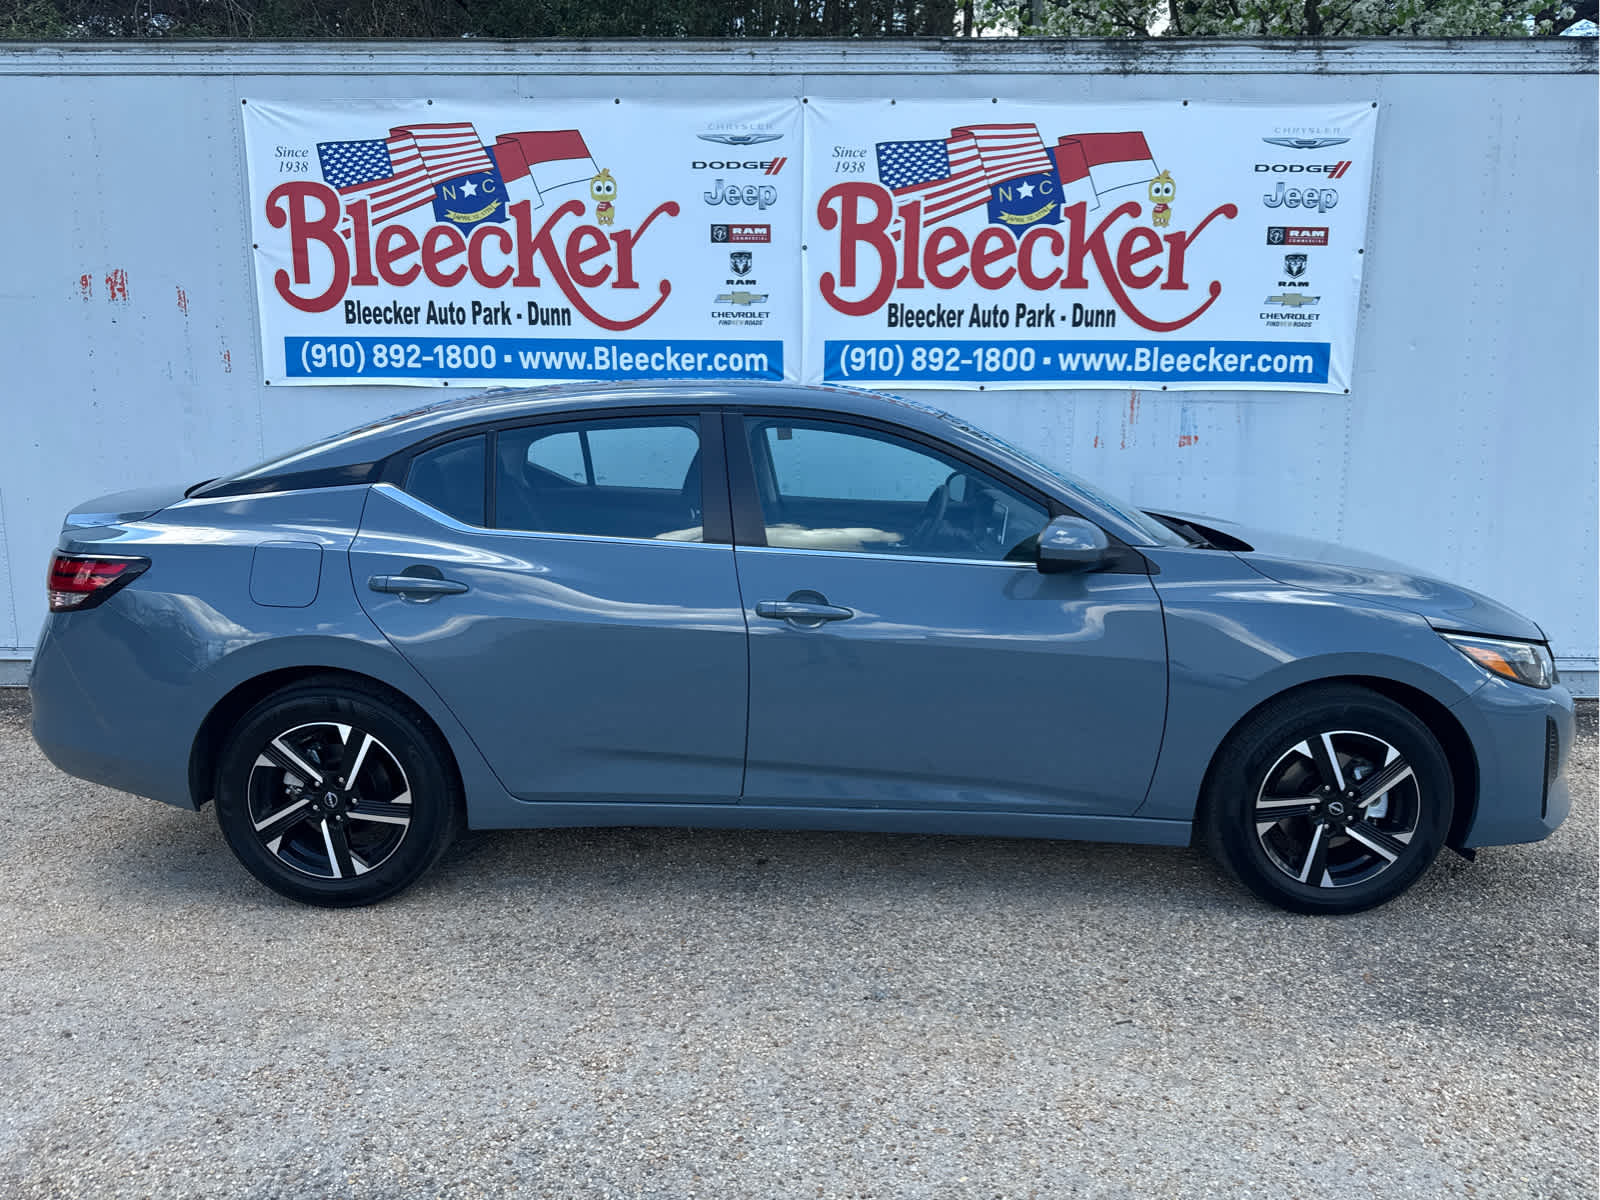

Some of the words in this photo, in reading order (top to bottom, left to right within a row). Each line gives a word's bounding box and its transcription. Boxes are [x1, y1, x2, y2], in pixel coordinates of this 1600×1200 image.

[1274, 127, 1342, 135] CHRYSLER
[275, 145, 309, 158] Since
[832, 146, 867, 159] Since
[279, 161, 309, 172] 1938
[692, 161, 773, 169] DODGE
[833, 162, 865, 173] 1938
[1254, 164, 1337, 172] DODGE
[442, 185, 456, 200] N
[482, 179, 496, 193] C
[704, 179, 778, 210] Jeep
[999, 186, 1013, 202] N
[1039, 180, 1053, 195] C
[1263, 182, 1339, 213] Jeep
[265, 181, 680, 331] Bleecker
[817, 181, 1238, 332] Bleecker
[344, 300, 421, 325] Bleecker
[426, 300, 466, 325] Auto
[472, 301, 512, 325] Park
[527, 302, 572, 326] Dunn
[887, 303, 964, 328] Bleecker
[968, 303, 1009, 328] Auto
[1015, 303, 1055, 328] Park
[1072, 303, 1116, 328] Dunn
[301, 341, 366, 372] (910)
[372, 344, 497, 370] 892-1800
[518, 346, 769, 373] www.Bleecker.com
[840, 344, 905, 376] (910)
[911, 347, 1036, 372] 892-1800
[1058, 347, 1314, 375] www.Bleecker.com
